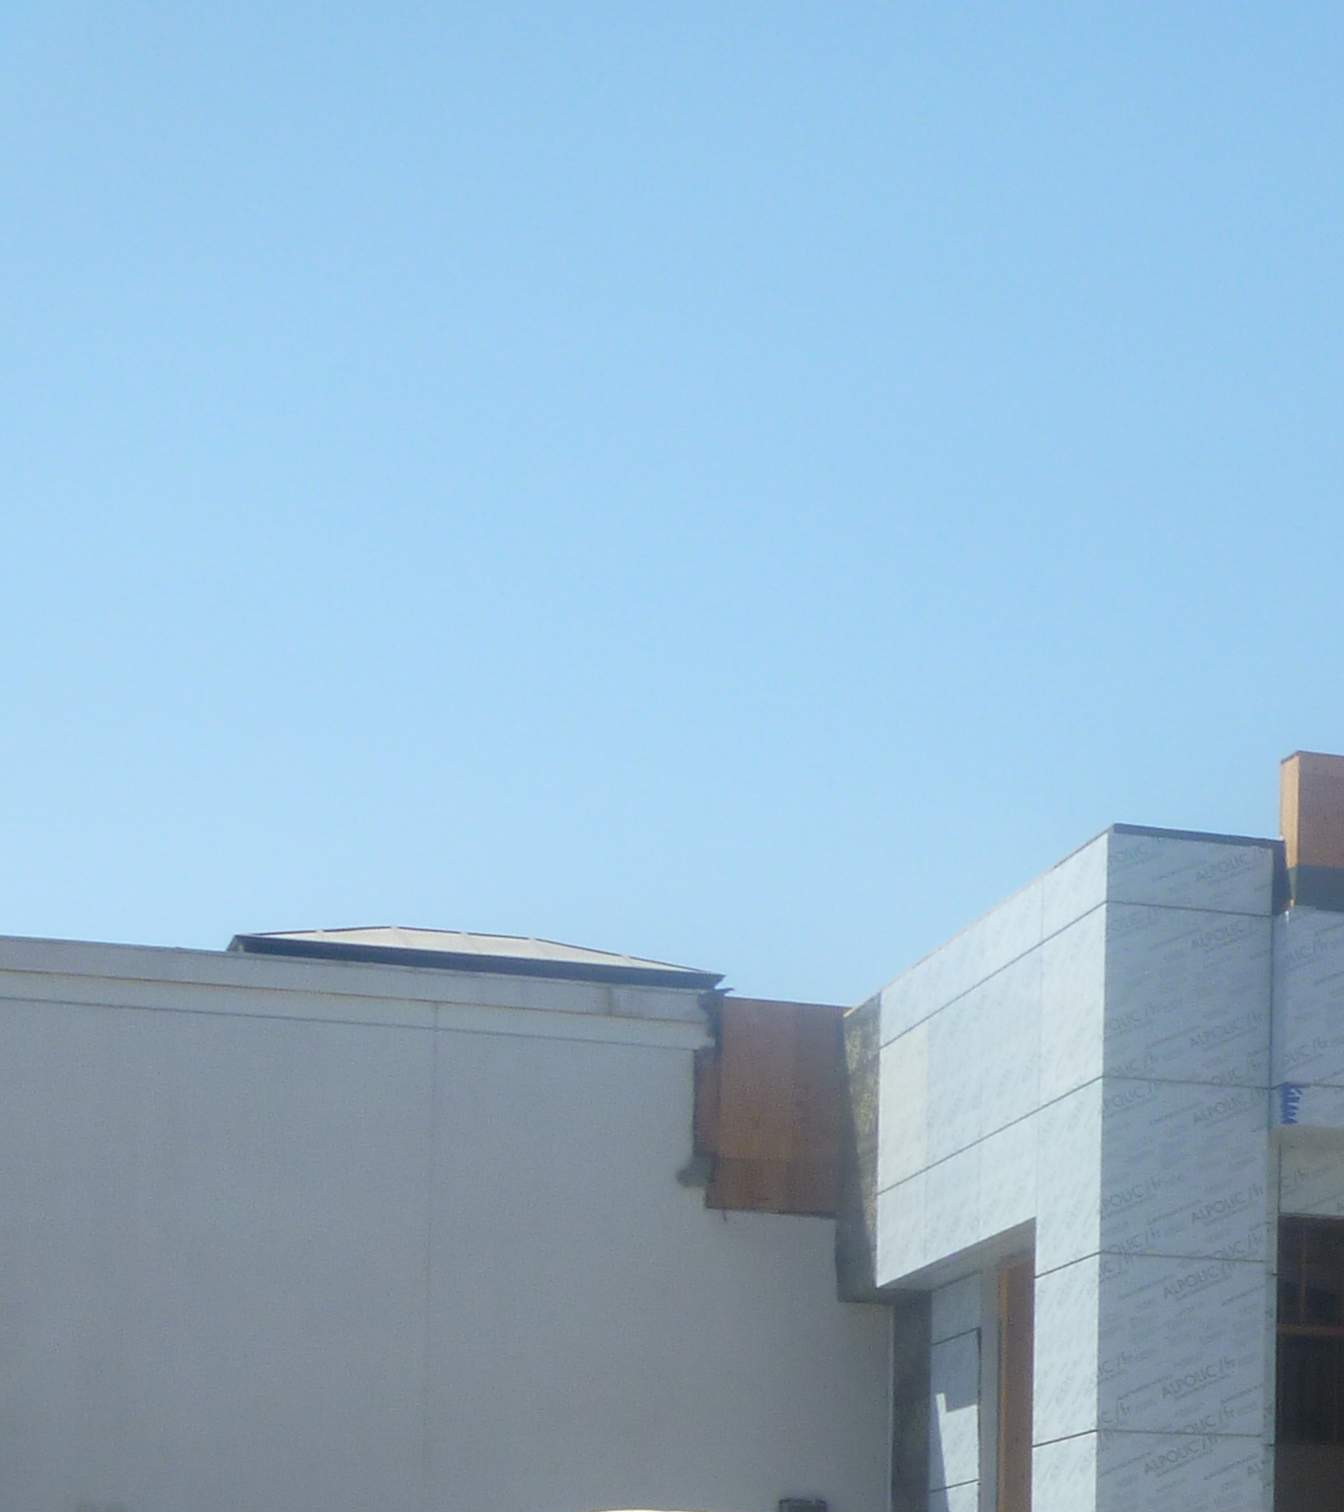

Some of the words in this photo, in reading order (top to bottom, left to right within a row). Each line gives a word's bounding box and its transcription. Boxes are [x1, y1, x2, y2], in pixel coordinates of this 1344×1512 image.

[1191, 1189, 1246, 1224] ALPOLIC
[1160, 1362, 1218, 1399] ALPOLIC
[1143, 1440, 1203, 1475] ALPOLIC
